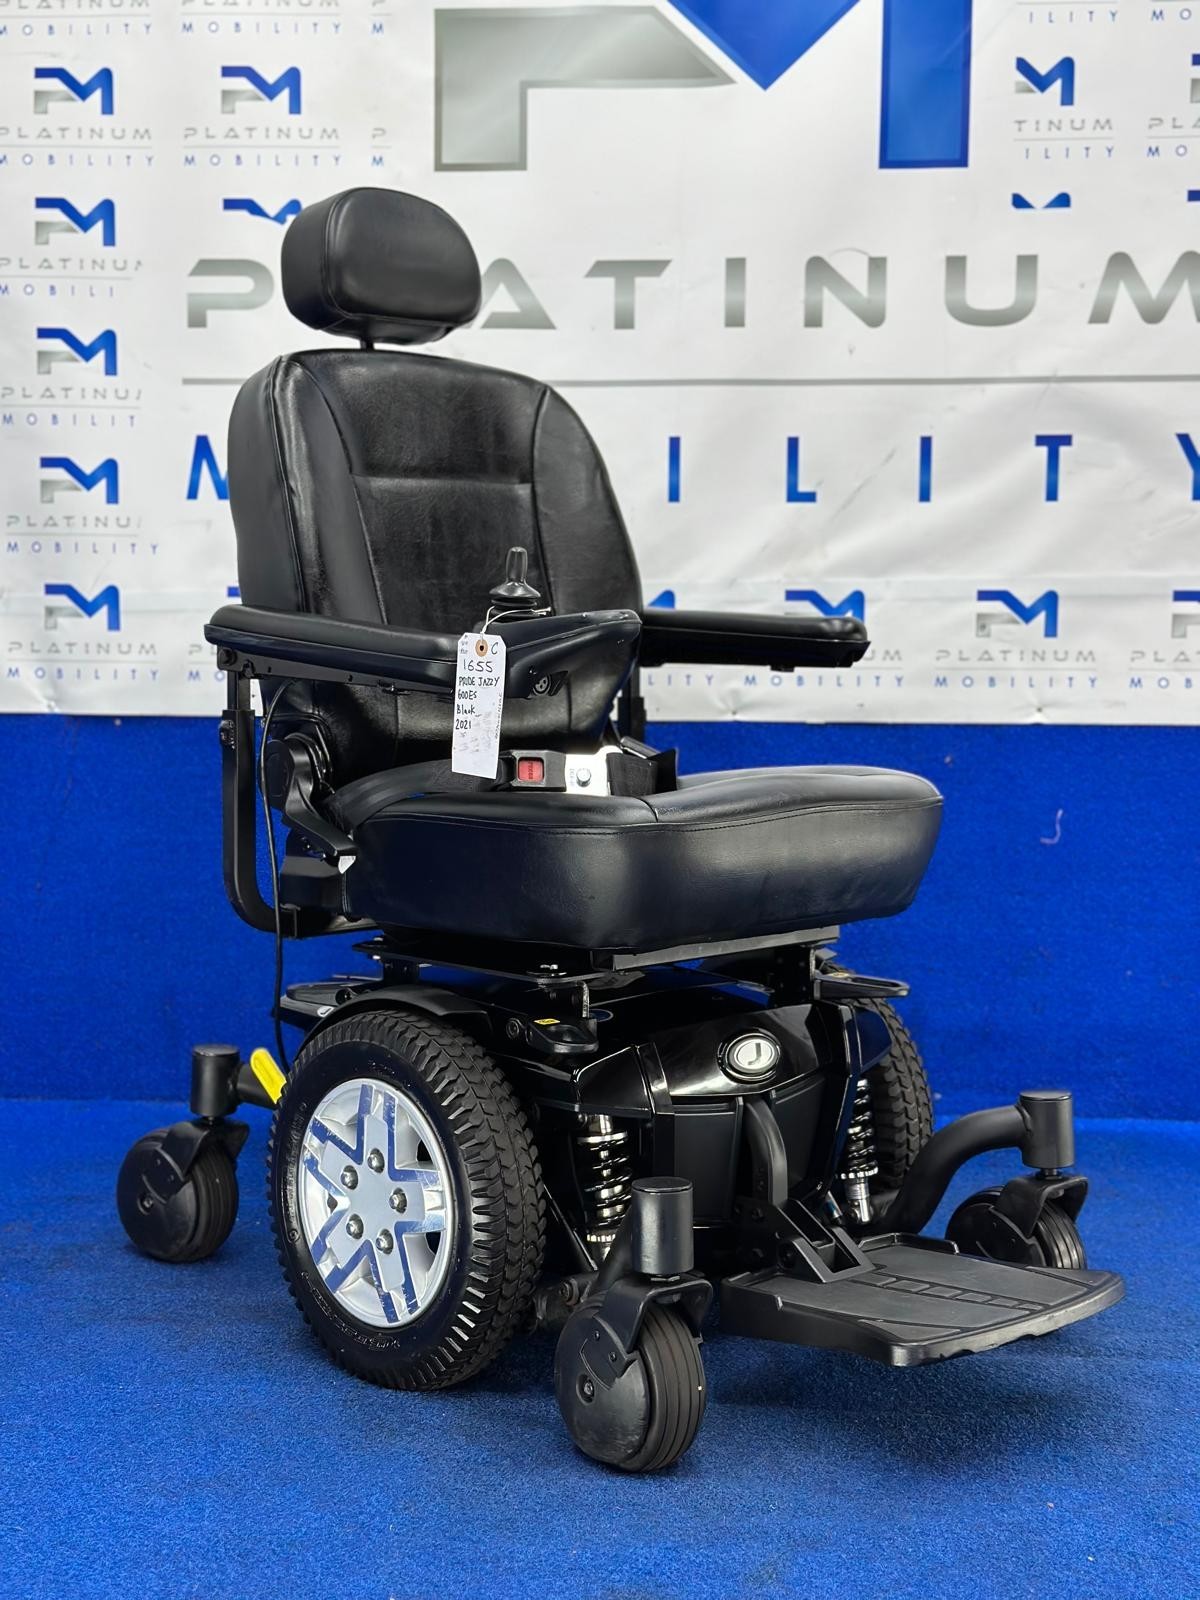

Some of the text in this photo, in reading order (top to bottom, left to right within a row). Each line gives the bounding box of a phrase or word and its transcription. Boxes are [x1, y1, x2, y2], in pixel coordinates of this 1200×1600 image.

[0, 24, 151, 35] MOBILITY
[181, 22, 340, 34] MOBILITY
[0, 127, 151, 140] PLATINUM
[184, 127, 339, 139] PLATINUM
[0, 154, 153, 166] MOBILITY
[184, 154, 340, 166] MOBILITY
[187, 250, 1200, 328] PATINUM
[187, 434, 1200, 502] MILITY
[7, 541, 158, 554] MOBILITY
[8, 641, 157, 655] PLATINUM
[491, 641, 498, 655] C
[935, 650, 1097, 662] PLATINUM
[463, 659, 493, 672] 1655
[7, 667, 158, 680] MOBILITY
[744, 675, 904, 687] MOBILITY
[934, 676, 1098, 689] MOBILITY
[455, 719, 471, 730] 2021
